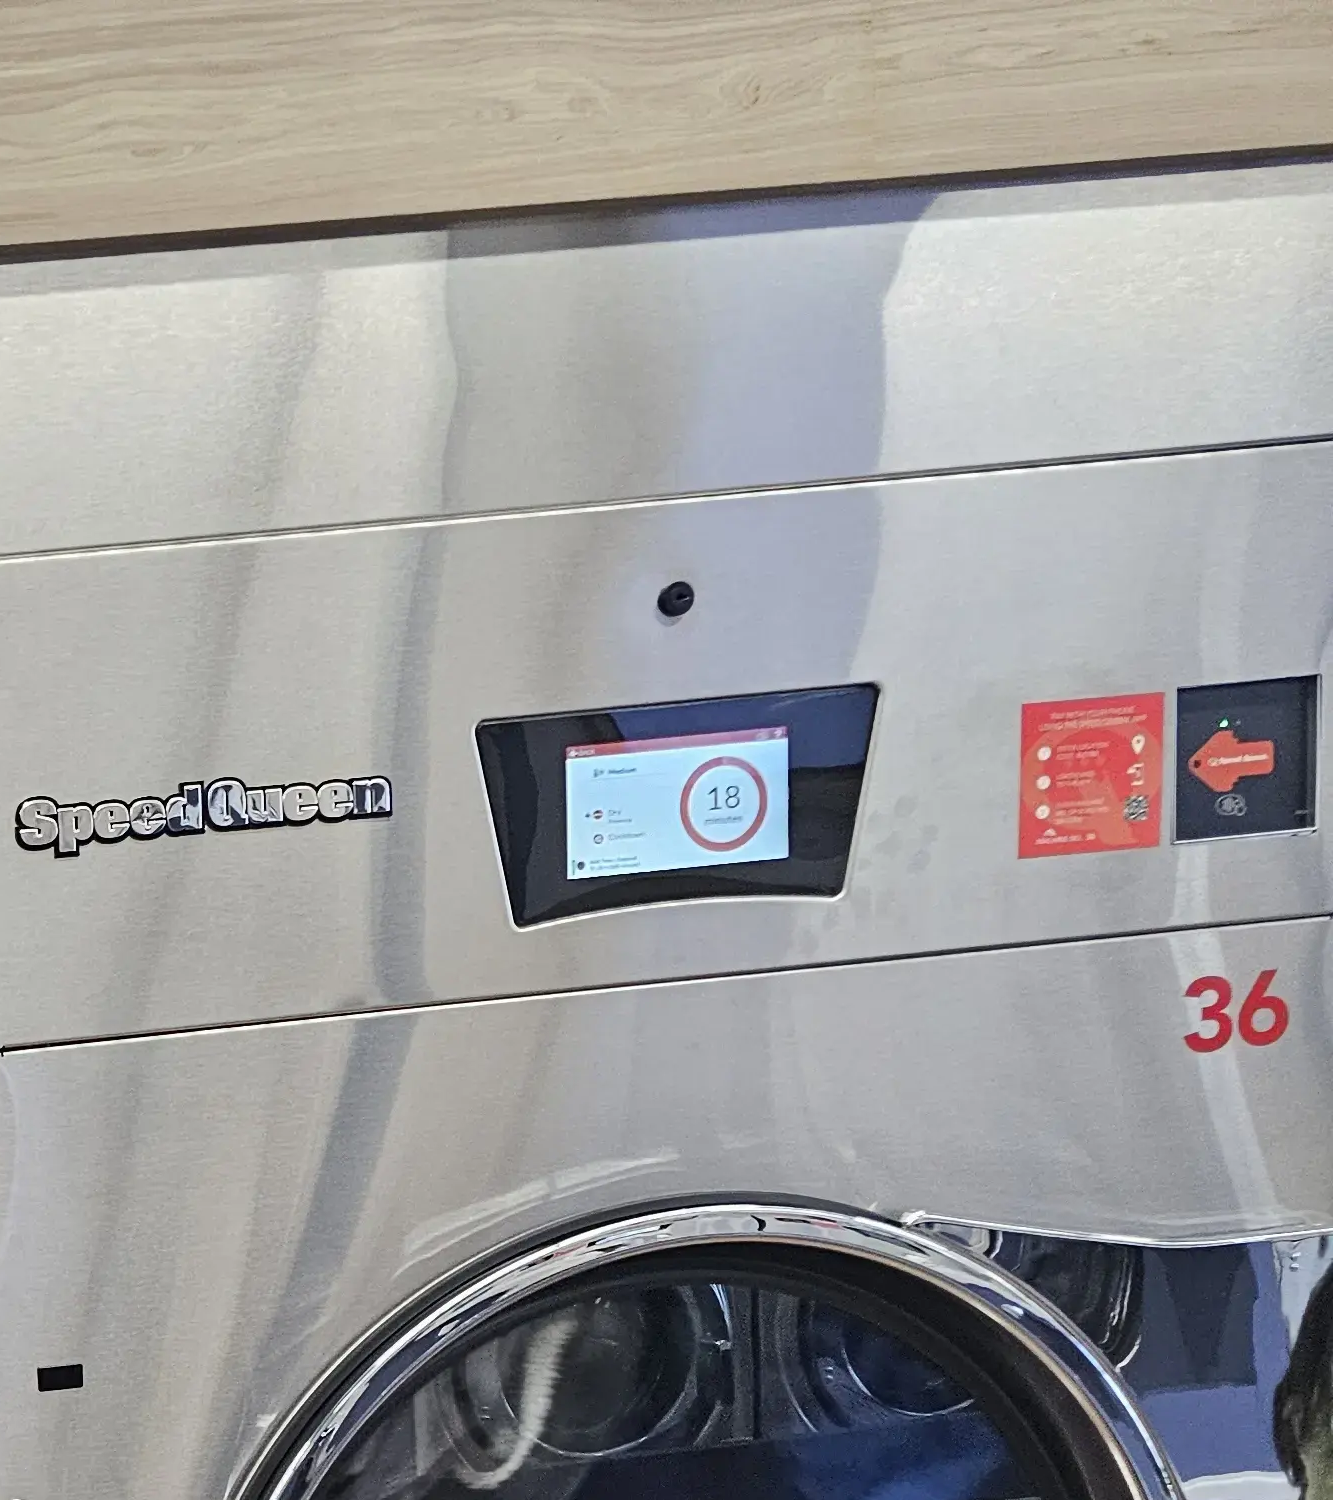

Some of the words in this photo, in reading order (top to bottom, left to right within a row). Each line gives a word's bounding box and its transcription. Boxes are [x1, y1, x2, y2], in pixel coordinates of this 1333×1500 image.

[15, 781, 206, 858] Speed
[205, 775, 392, 831] Queen
[707, 785, 741, 811] 18
[1183, 968, 1290, 1053] 36
